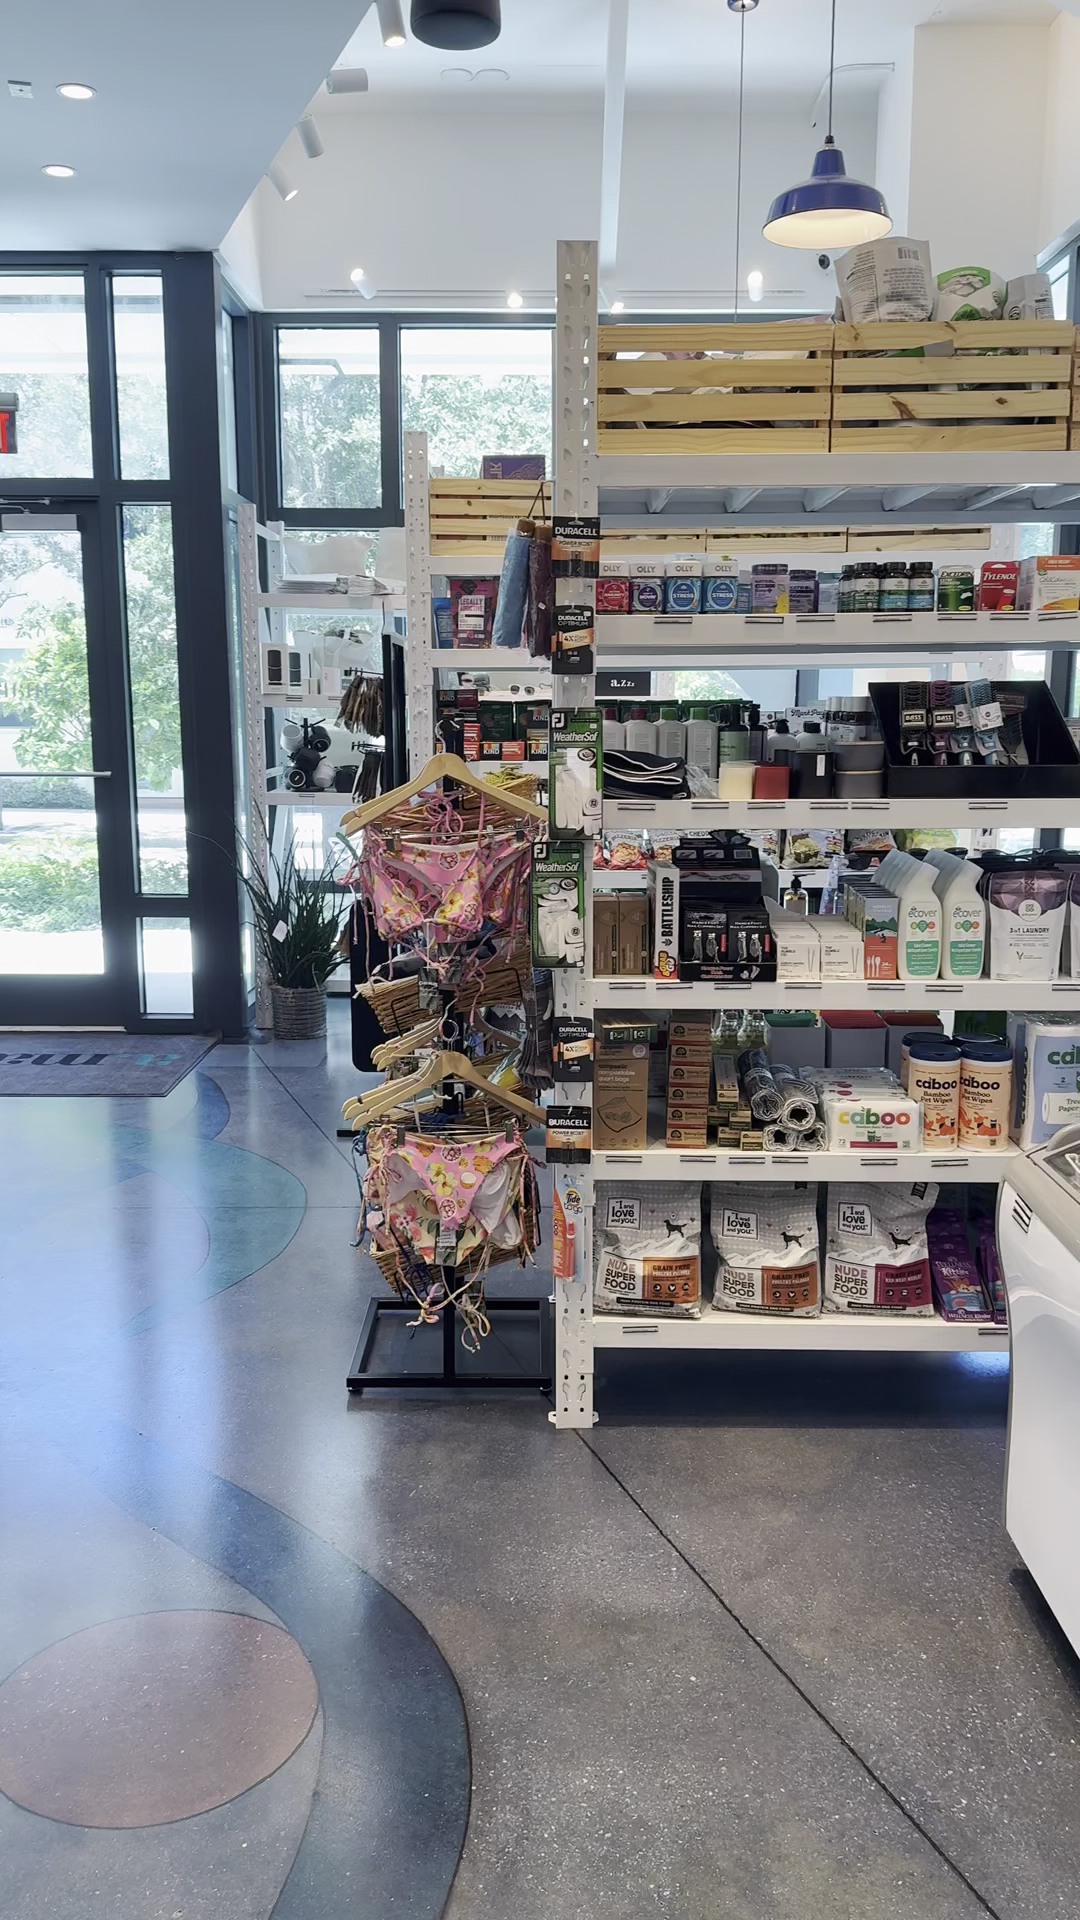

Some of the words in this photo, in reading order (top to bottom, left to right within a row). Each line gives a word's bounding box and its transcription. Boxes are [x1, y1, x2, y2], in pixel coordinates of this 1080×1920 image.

[555, 527, 598, 536] DURACELL
[636, 565, 656, 573] OLLY
[983, 572, 1017, 580] TYLENOL
[553, 732, 598, 742] WeatherSof
[535, 862, 580, 872] WeatherSof
[661, 876, 674, 937] BATTLESHIP
[916, 1078, 957, 1090] caboo
[963, 1089, 990, 1097] Bamboo
[971, 1096, 993, 1104] Wipes
[838, 1108, 911, 1125] caboo
[566, 1193, 581, 1204] Tide
[611, 1206, 635, 1217] love
[843, 1211, 865, 1224] love
[727, 1216, 751, 1228] love
[607, 1258, 636, 1273] NUDE
[835, 1264, 868, 1279] NUDE
[605, 1269, 636, 1282] SUPER
[723, 1267, 754, 1281] NUDE
[834, 1274, 868, 1287] SUPER
[604, 1277, 636, 1291] FOOD
[722, 1275, 755, 1289] SUPER
[722, 1284, 755, 1298] FOOD
[833, 1282, 868, 1296] FOOD
